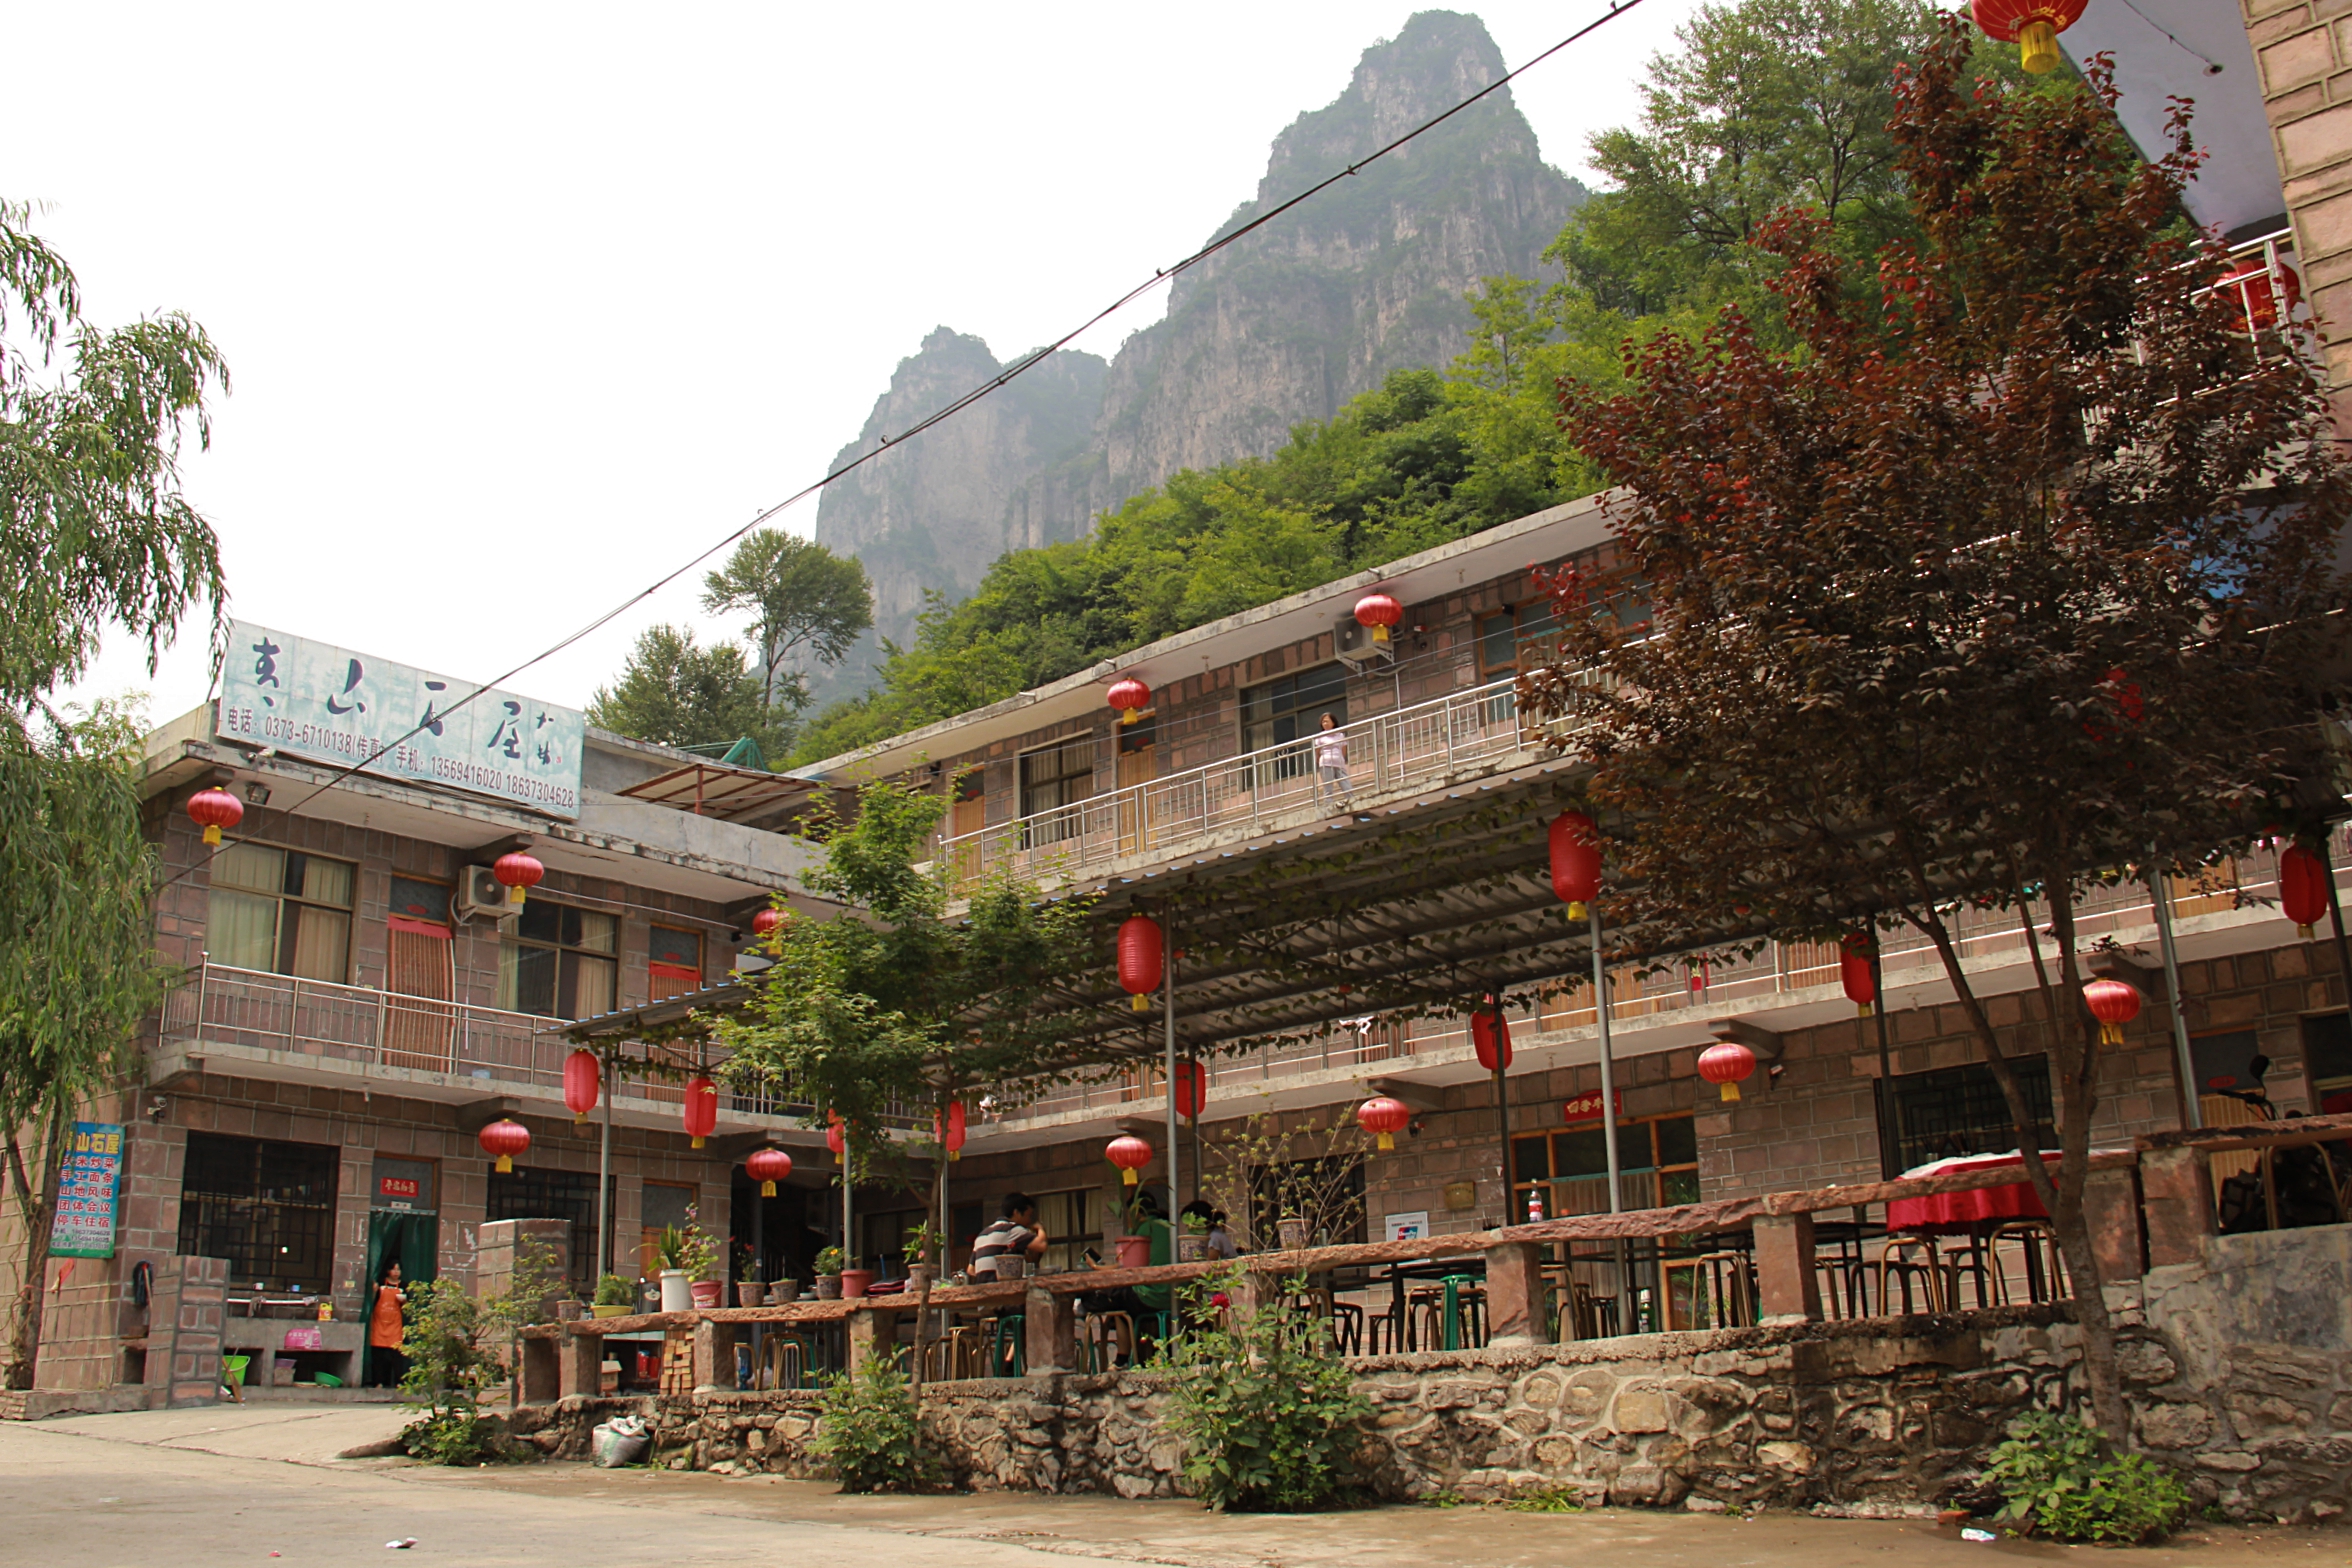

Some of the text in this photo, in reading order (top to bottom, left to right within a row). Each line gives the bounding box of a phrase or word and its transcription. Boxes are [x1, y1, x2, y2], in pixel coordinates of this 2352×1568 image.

[506, 774, 574, 808] 18637304628
[60, 1170, 113, 1183] 手工面条
[60, 1185, 112, 1198] 山地风味
[58, 1200, 111, 1213] 团体会议
[57, 1214, 110, 1228] 停车住宿
